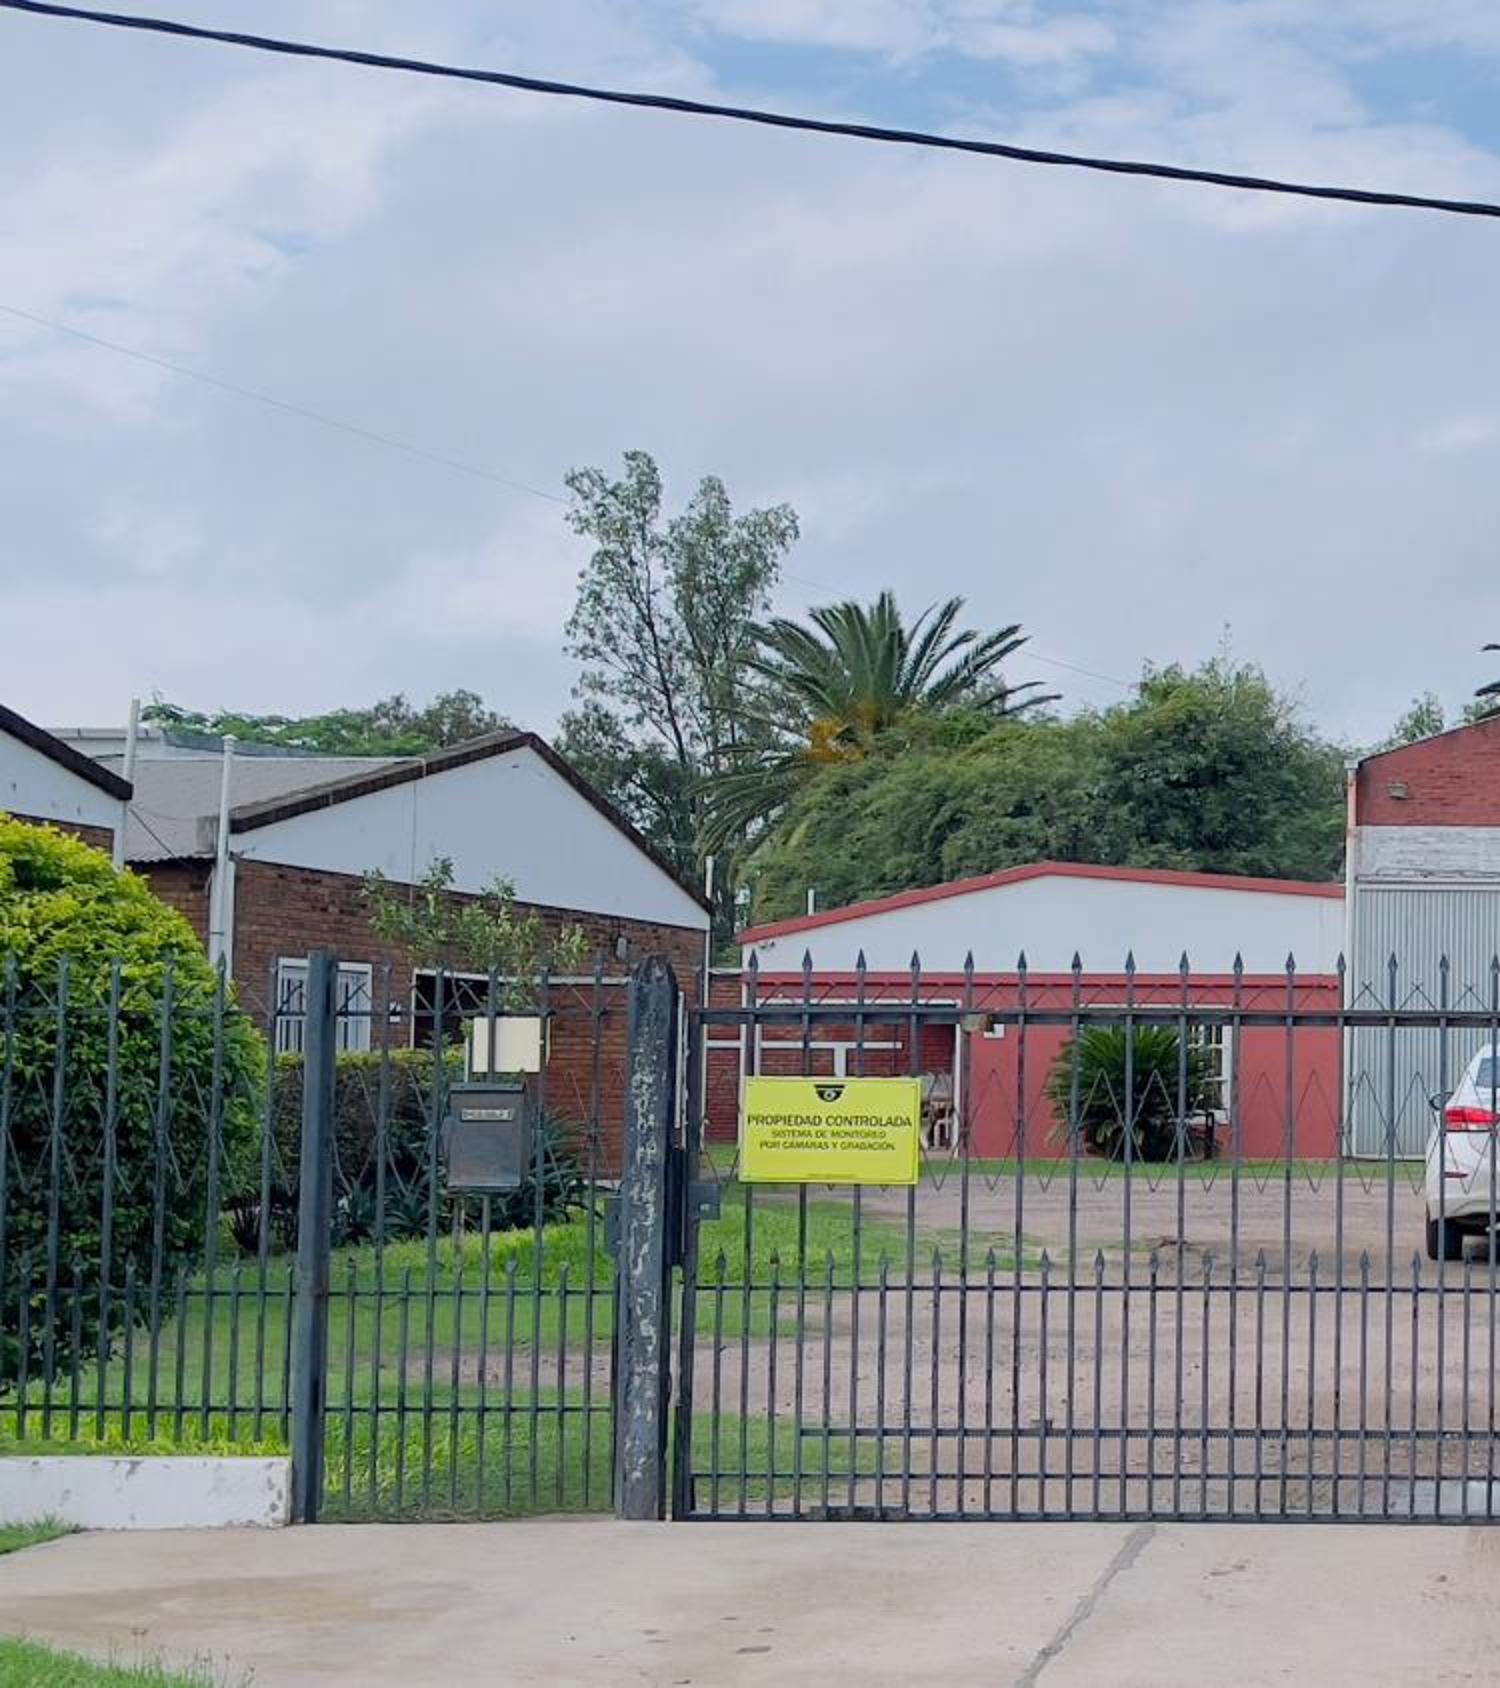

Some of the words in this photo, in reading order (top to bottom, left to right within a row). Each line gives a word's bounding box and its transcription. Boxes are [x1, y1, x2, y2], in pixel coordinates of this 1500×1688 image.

[747, 1114, 822, 1126] PROPIEDAD
[826, 1115, 912, 1127] CONTROLADA
[771, 1129, 812, 1138] SISTEMA
[815, 1129, 827, 1138] DE
[831, 1129, 886, 1138] MONITOREO
[760, 1140, 780, 1149] POR
